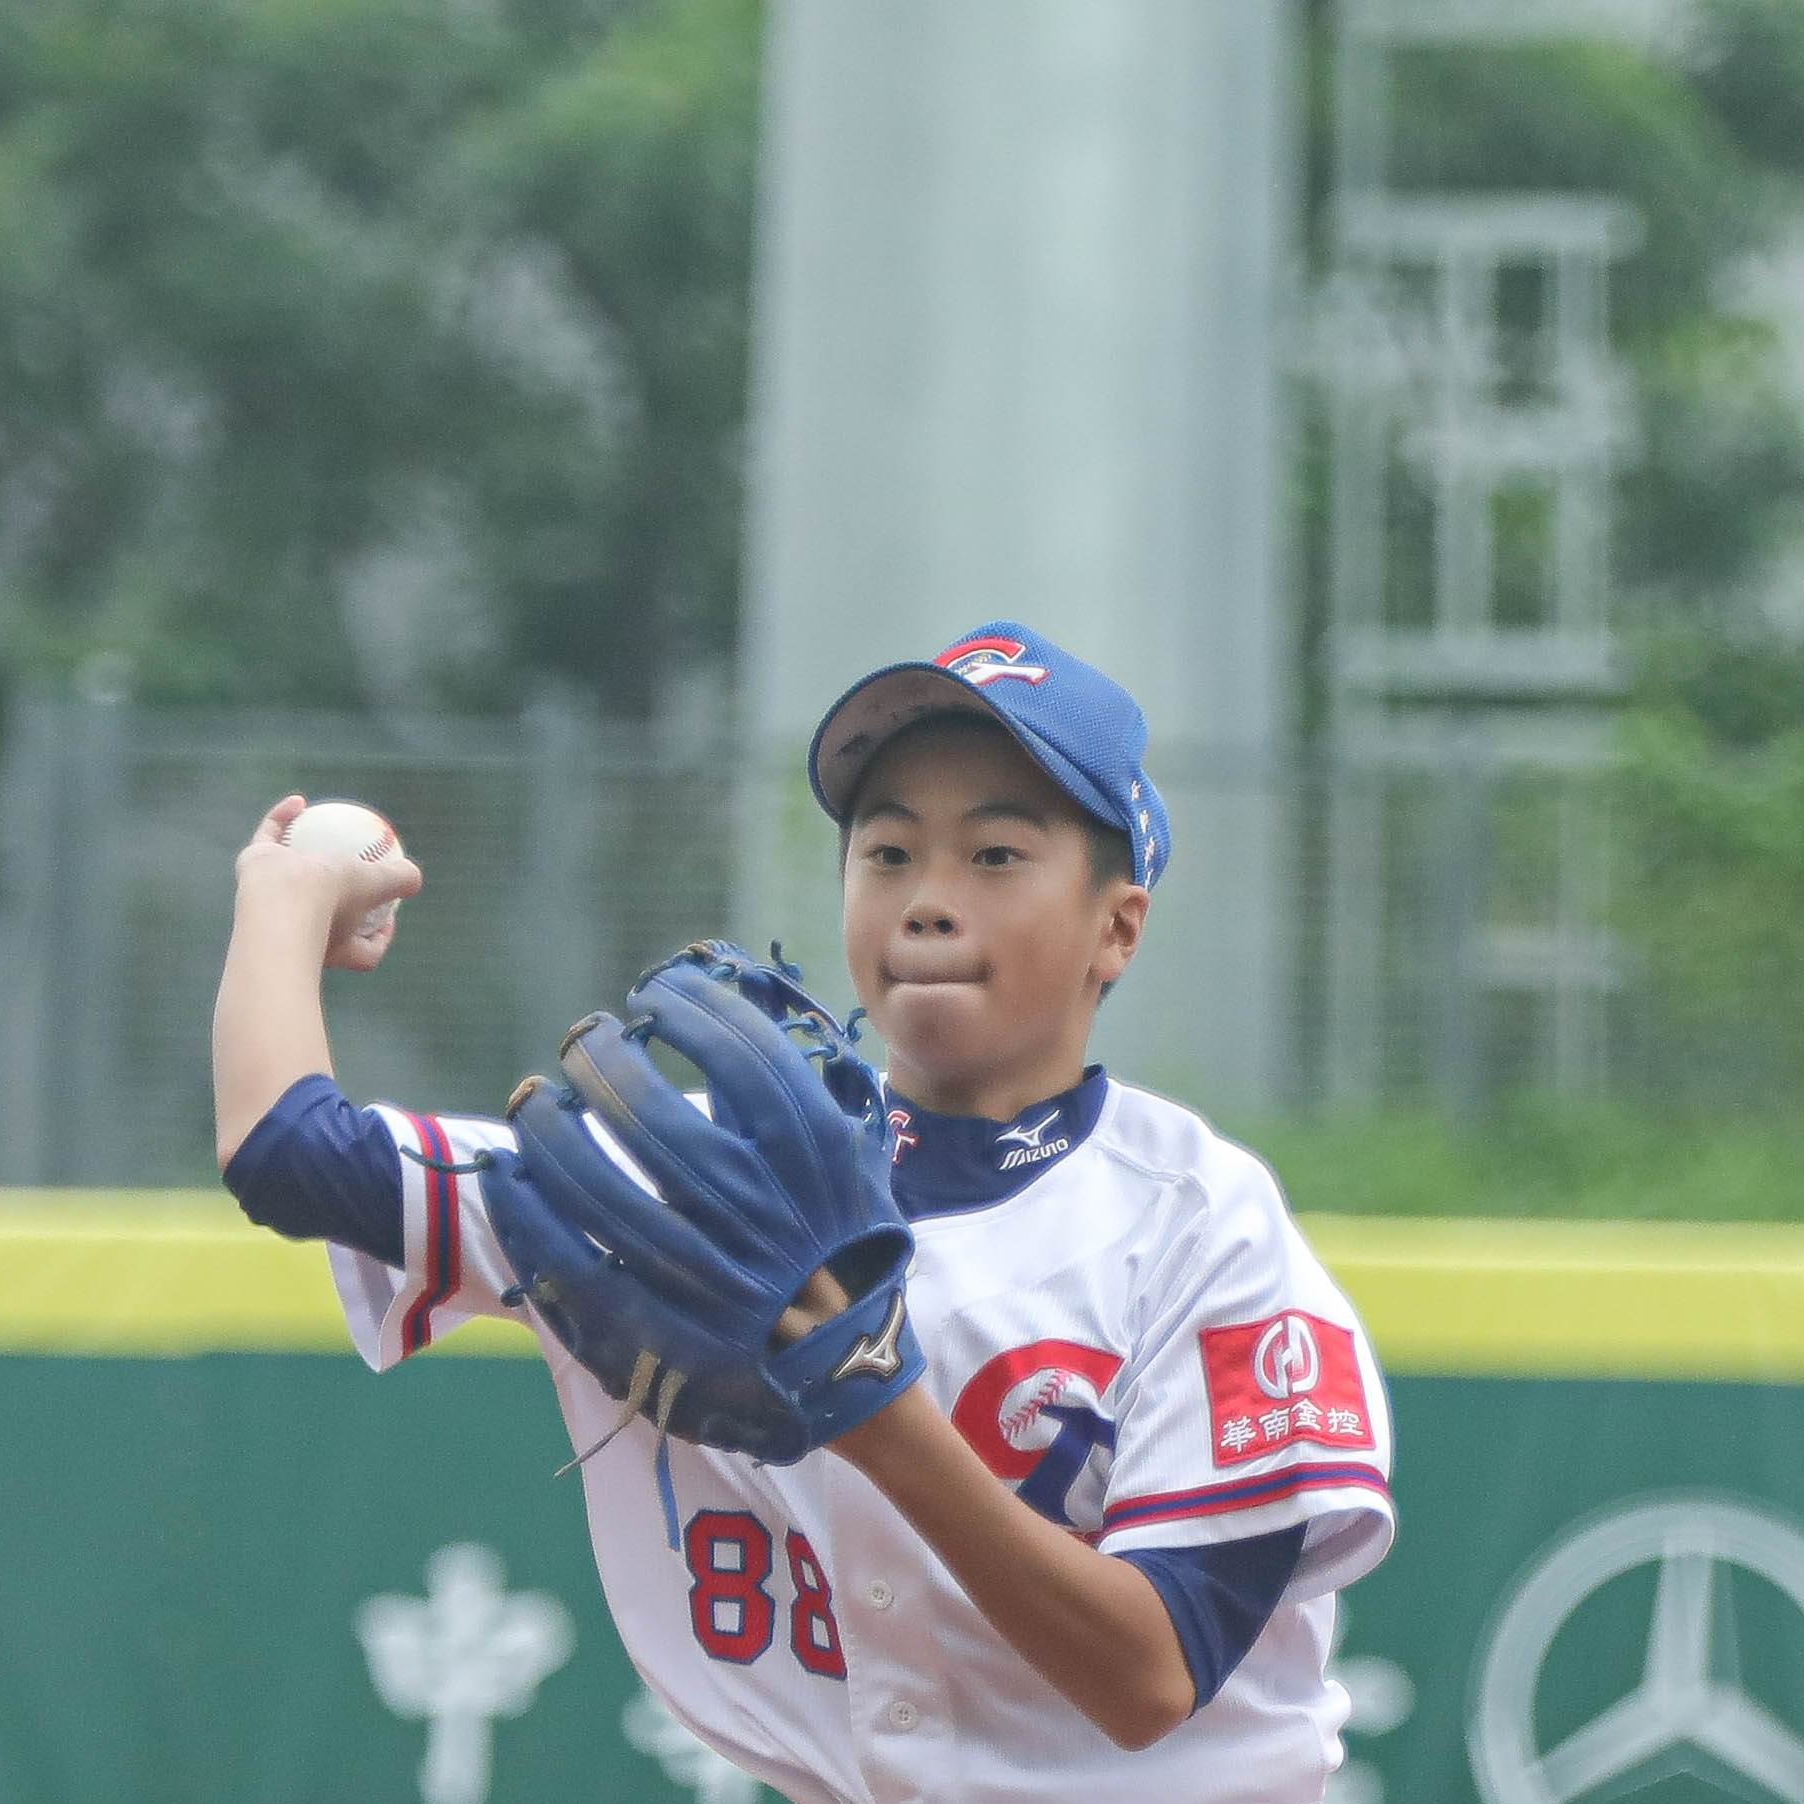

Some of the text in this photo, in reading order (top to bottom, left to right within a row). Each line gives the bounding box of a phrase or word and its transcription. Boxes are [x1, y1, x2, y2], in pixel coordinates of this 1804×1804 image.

[1220, 1397, 1365, 1453] 華南金控
[683, 1508, 848, 1682] 88
